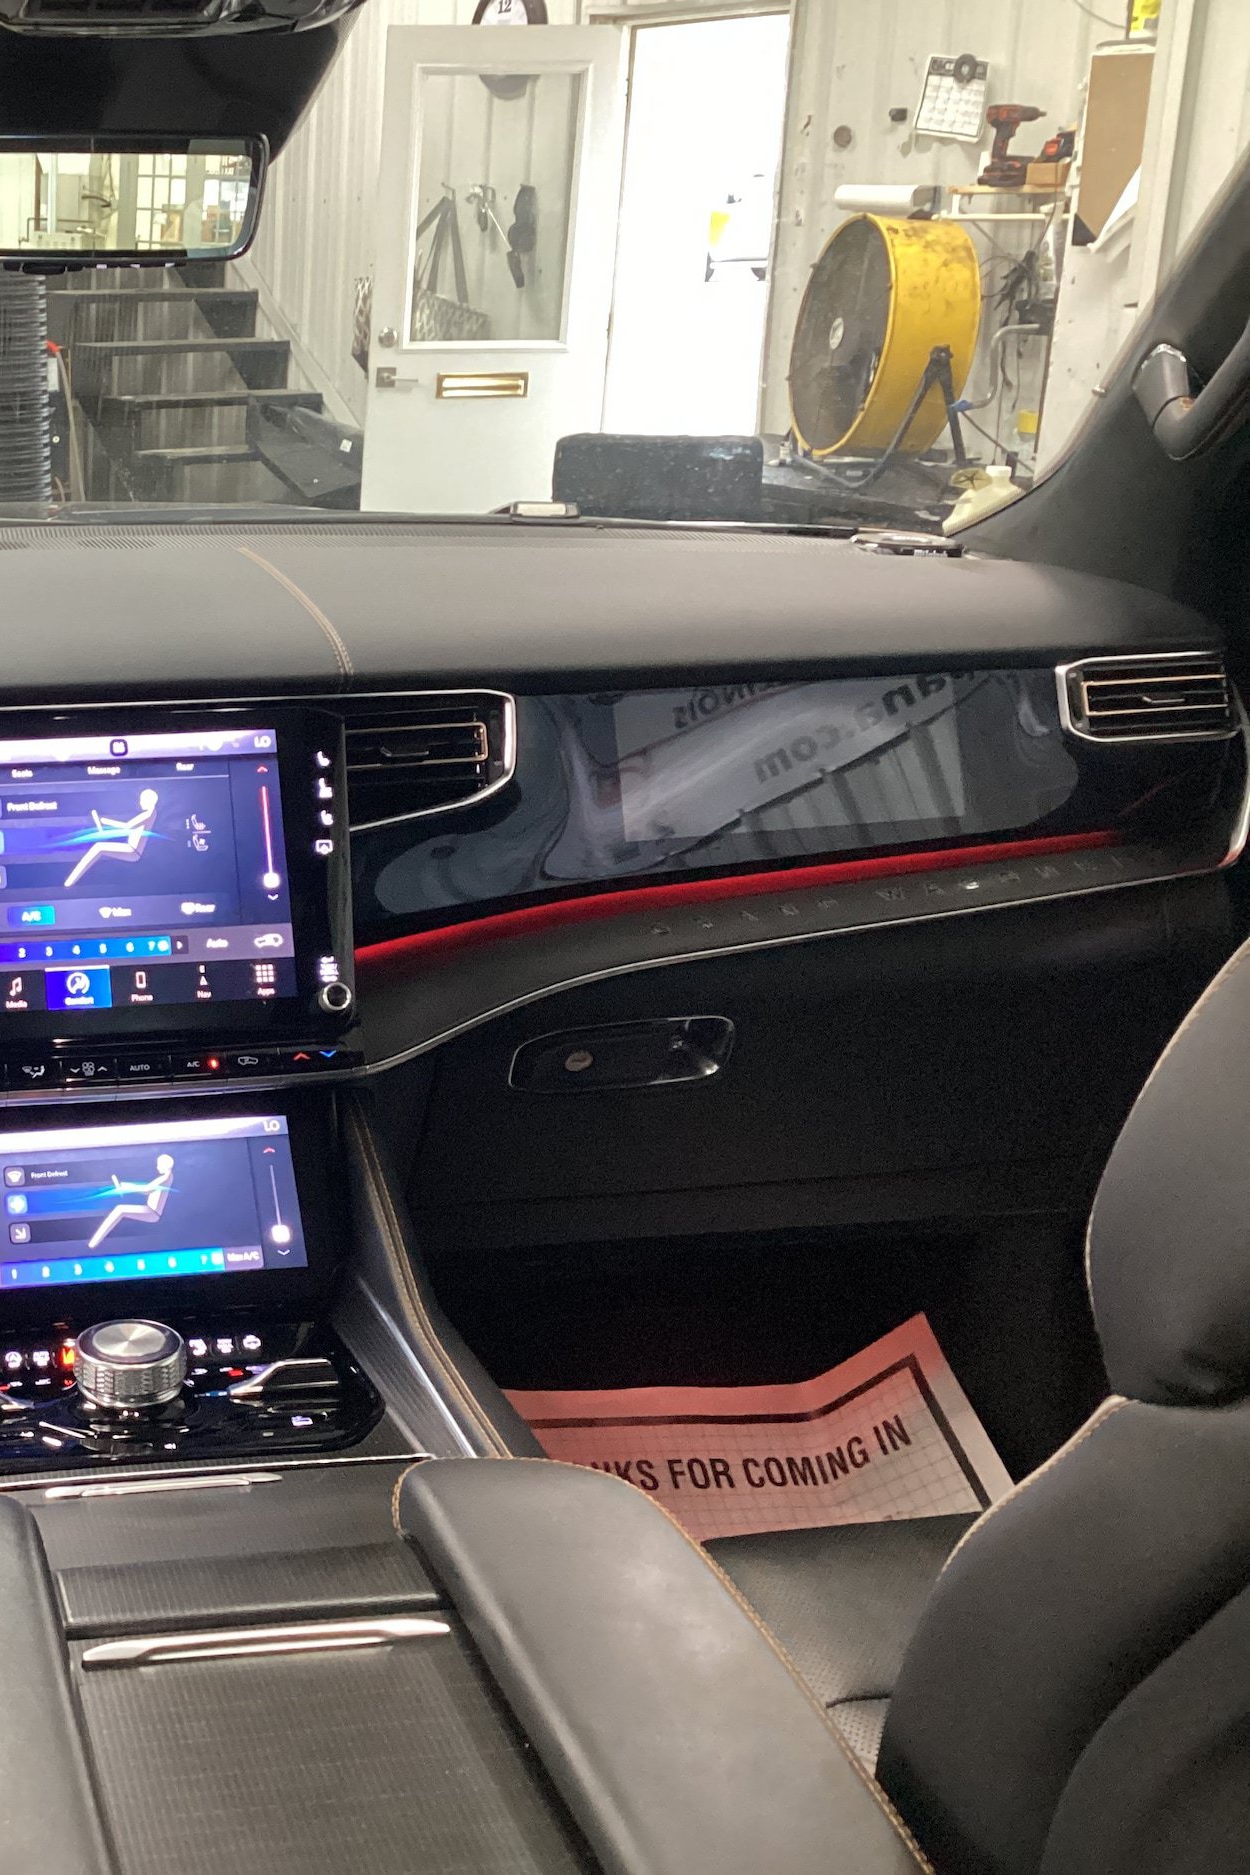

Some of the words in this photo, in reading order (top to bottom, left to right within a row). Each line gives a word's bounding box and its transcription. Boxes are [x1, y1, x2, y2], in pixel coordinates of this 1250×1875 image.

[498, 0, 512, 14] 12
[254, 735, 271, 748] LO
[206, 939, 229, 949] Auto
[197, 991, 212, 1000] Nav
[258, 987, 276, 997] Apps
[131, 993, 154, 1002] Phone
[5, 1001, 28, 1010] Media
[130, 1063, 150, 1072] AUTO
[187, 1061, 200, 1069] A/C
[263, 1119, 280, 1132] LO
[670, 1458, 735, 1490] FOR
[744, 1436, 869, 1489] COMING
[873, 1414, 912, 1456] IN
